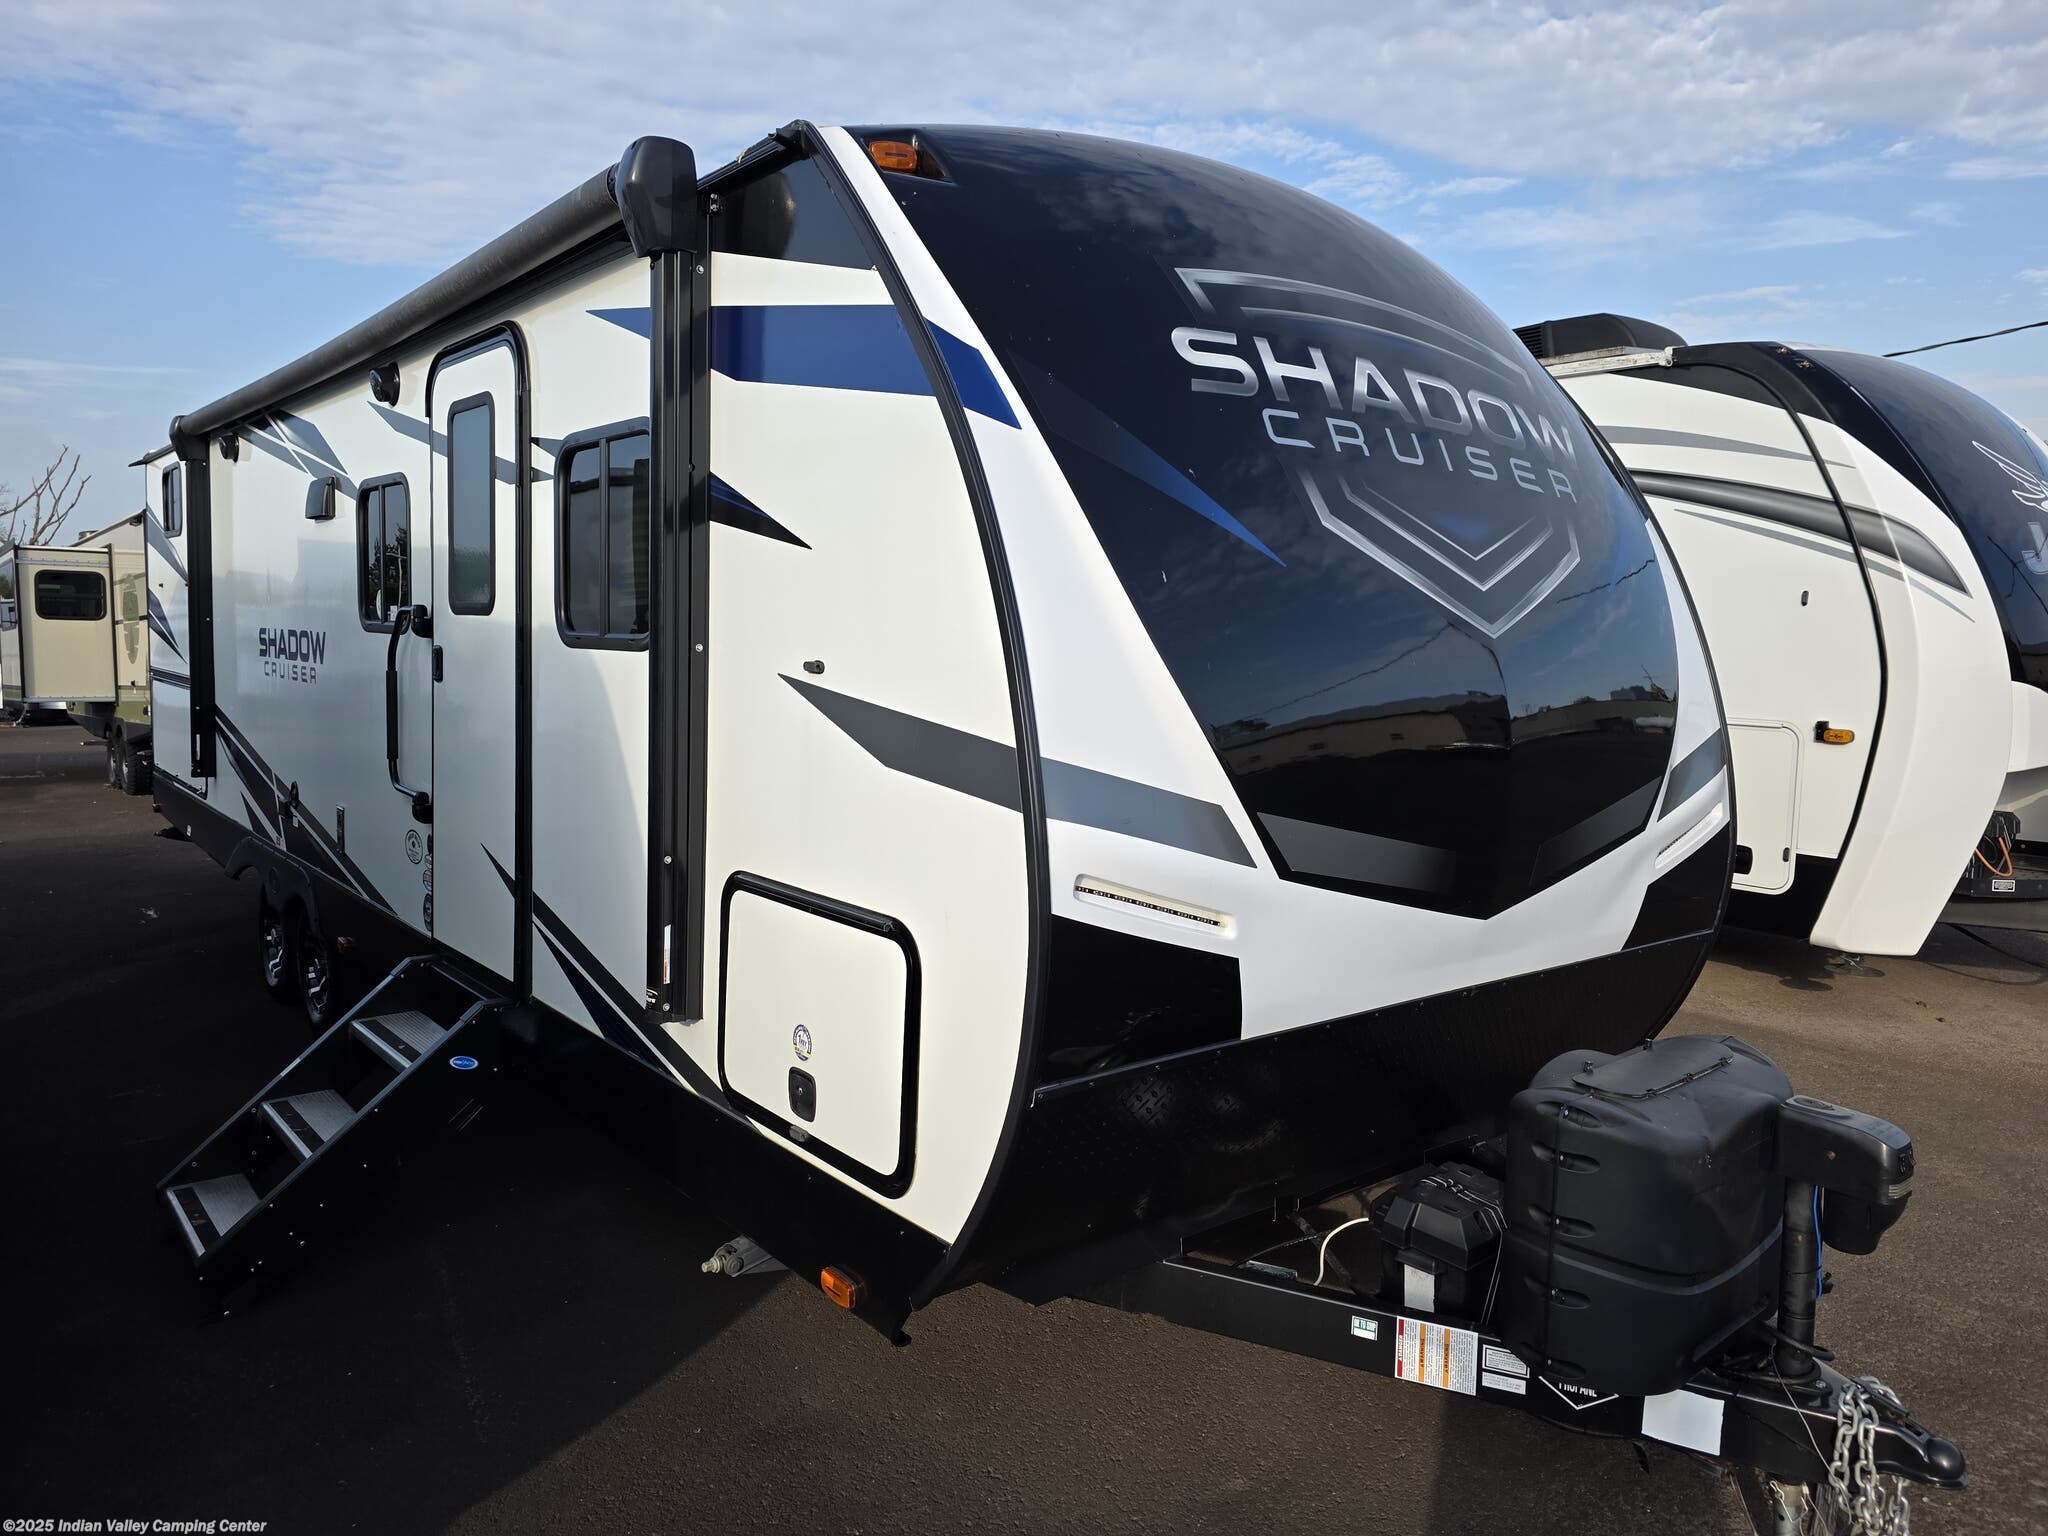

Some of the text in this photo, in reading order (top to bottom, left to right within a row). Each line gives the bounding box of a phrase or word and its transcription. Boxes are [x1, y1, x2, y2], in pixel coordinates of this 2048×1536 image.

[1170, 325, 1577, 470] SHADOW
[1261, 407, 1578, 504] CRUISER
[259, 628, 326, 664] SHADOW
[264, 661, 317, 685] CRUISER
